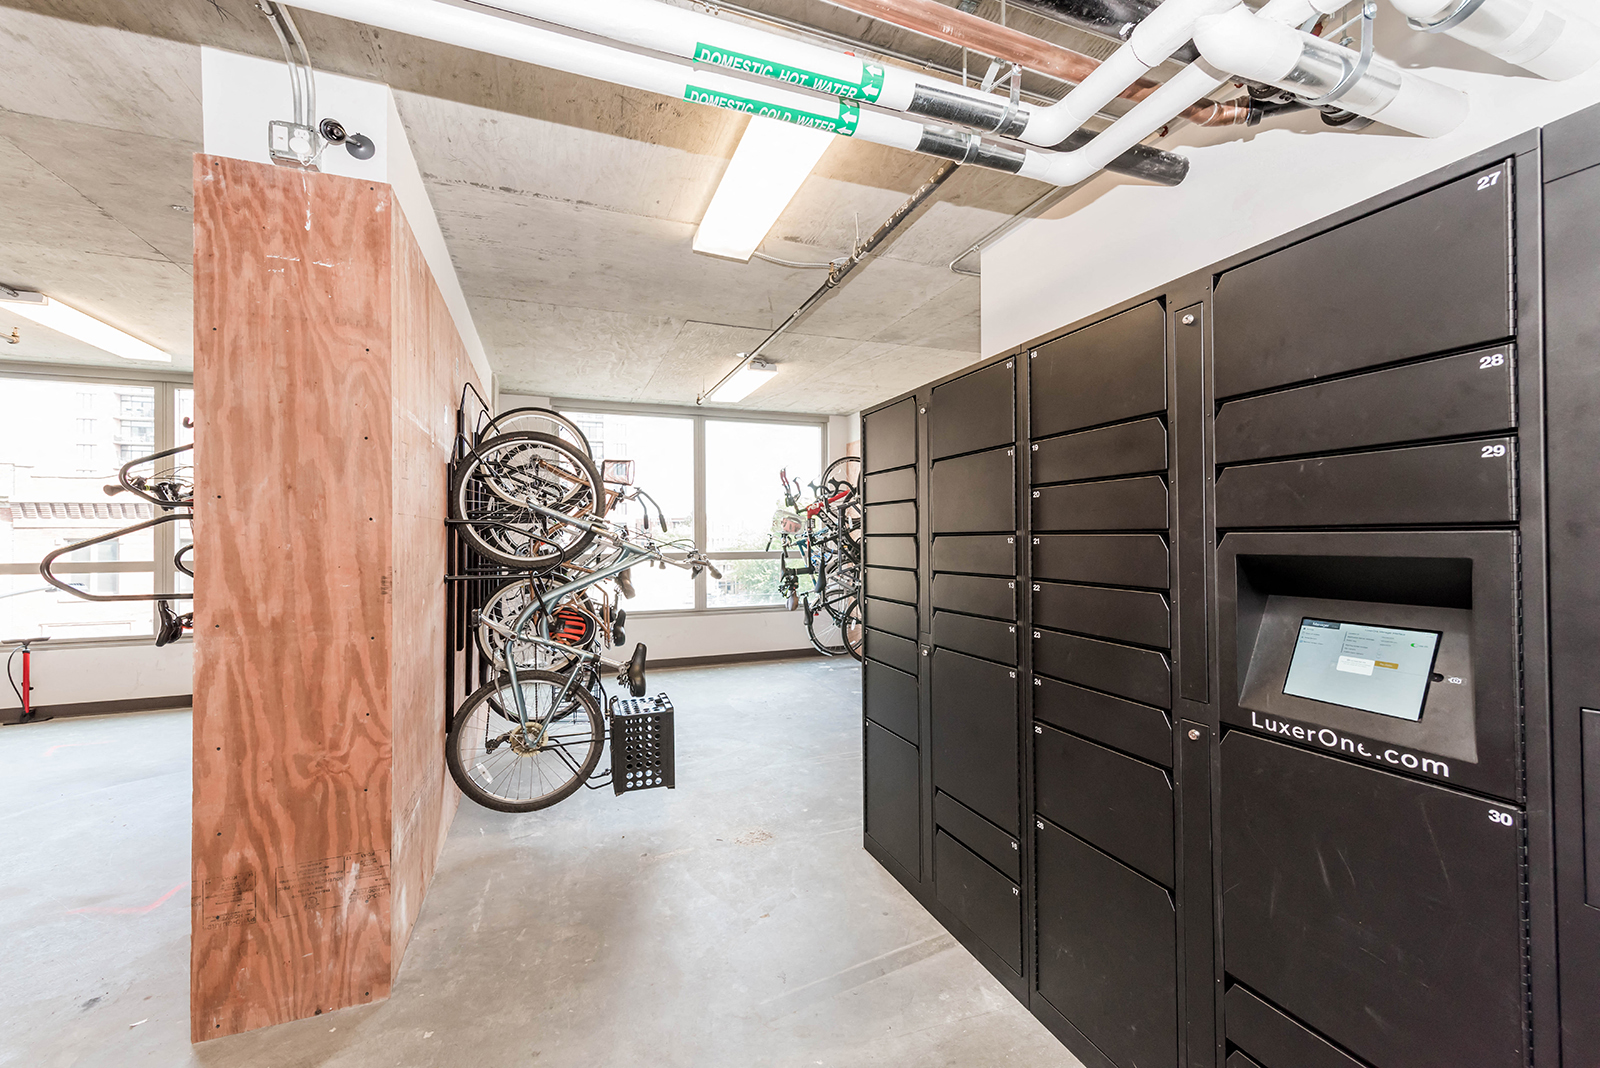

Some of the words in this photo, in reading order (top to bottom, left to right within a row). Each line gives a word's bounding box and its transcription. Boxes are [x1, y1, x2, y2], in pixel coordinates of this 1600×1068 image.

[699, 48, 773, 78] DOMESTIC
[778, 69, 809, 87] HOT
[813, 77, 858, 99] WATER
[690, 90, 754, 114] DOMESTIC
[758, 106, 792, 123] COLD
[797, 115, 836, 132] WATER
[1476, 171, 1501, 191] 27
[1030, 351, 1038, 359] 18
[1006, 361, 1013, 369] 10
[1479, 353, 1504, 369] 28
[1031, 444, 1039, 452] 19
[1481, 445, 1506, 458] 29
[1032, 490, 1040, 498] 20
[1033, 537, 1040, 545] 21
[1033, 584, 1041, 592] 22
[1033, 631, 1041, 639] 23
[1034, 678, 1042, 686] 24
[1034, 726, 1042, 734] 25
[1251, 711, 1450, 778] LuxerOne.com
[1488, 809, 1513, 827] 30
[1012, 887, 1019, 896] 17
